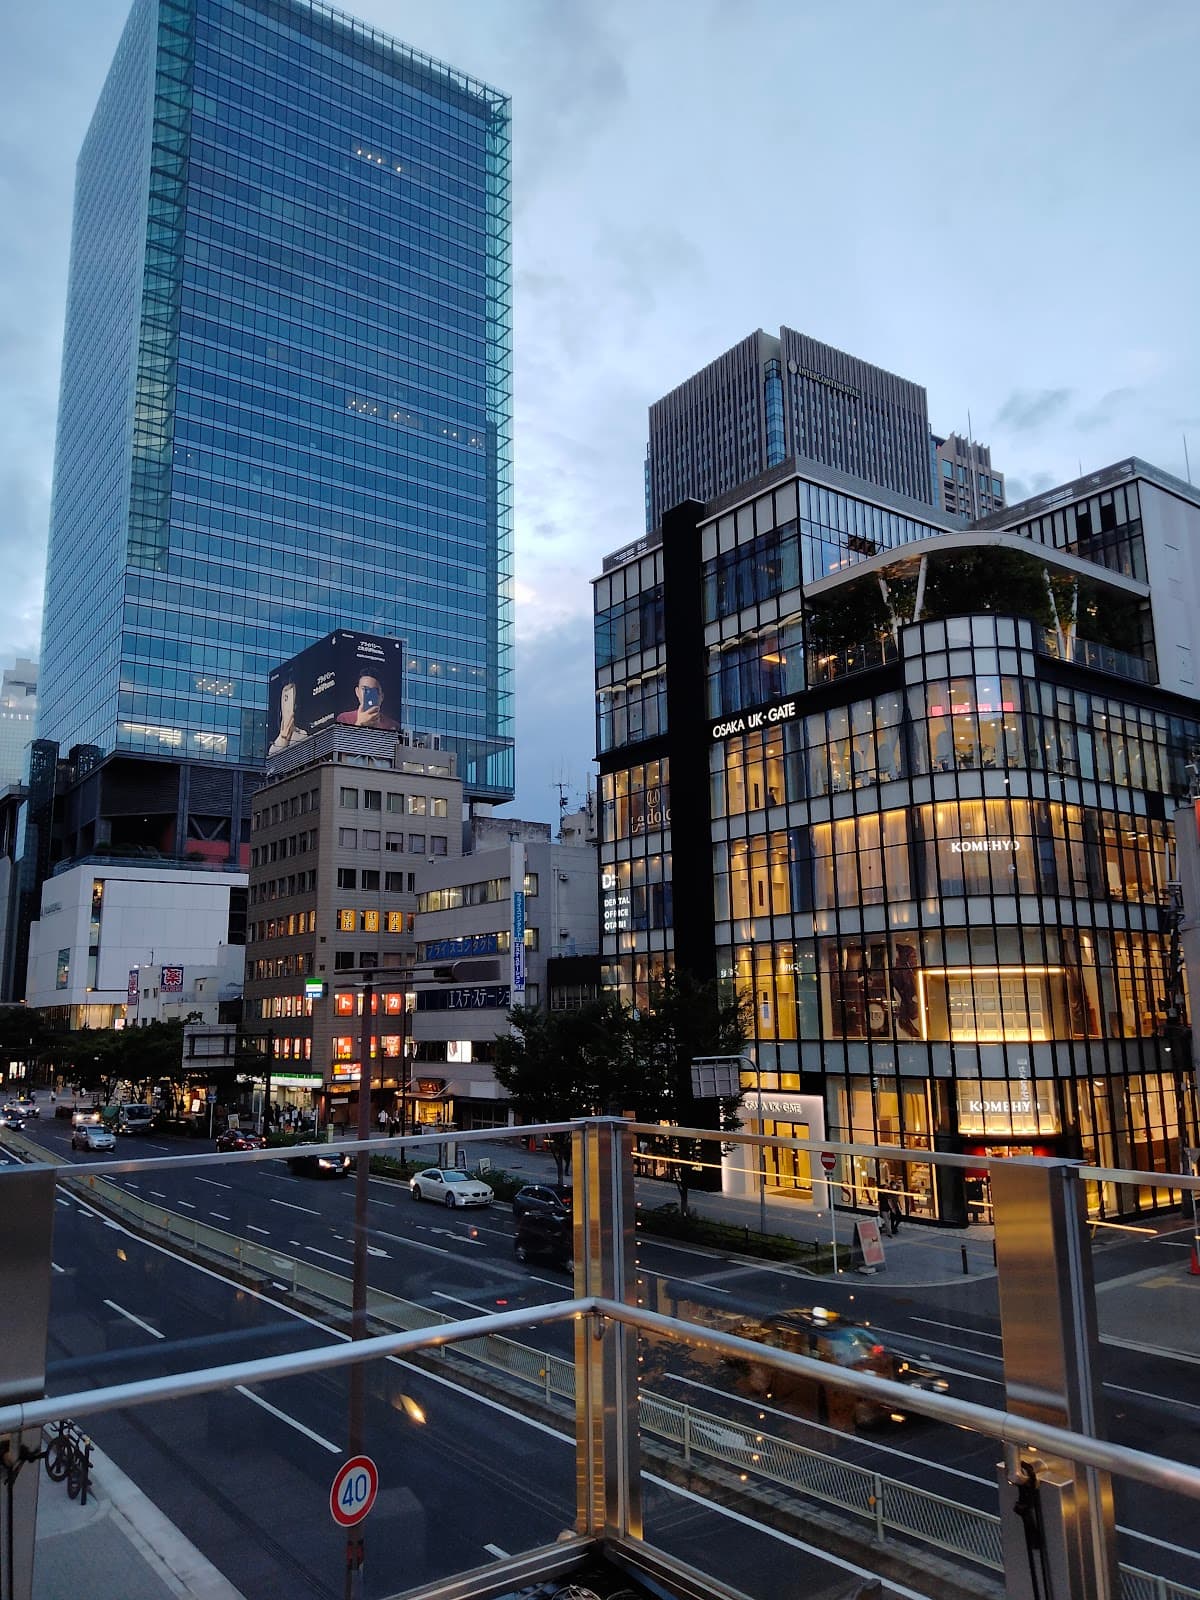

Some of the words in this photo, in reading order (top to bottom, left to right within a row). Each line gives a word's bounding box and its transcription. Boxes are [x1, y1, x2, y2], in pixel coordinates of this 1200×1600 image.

[712, 718, 746, 738] OSAKA
[604, 896, 631, 908] DENTAL
[604, 908, 629, 919] OFFICE
[969, 1100, 1040, 1113] KOMEHY
[342, 1473, 367, 1507] 40
